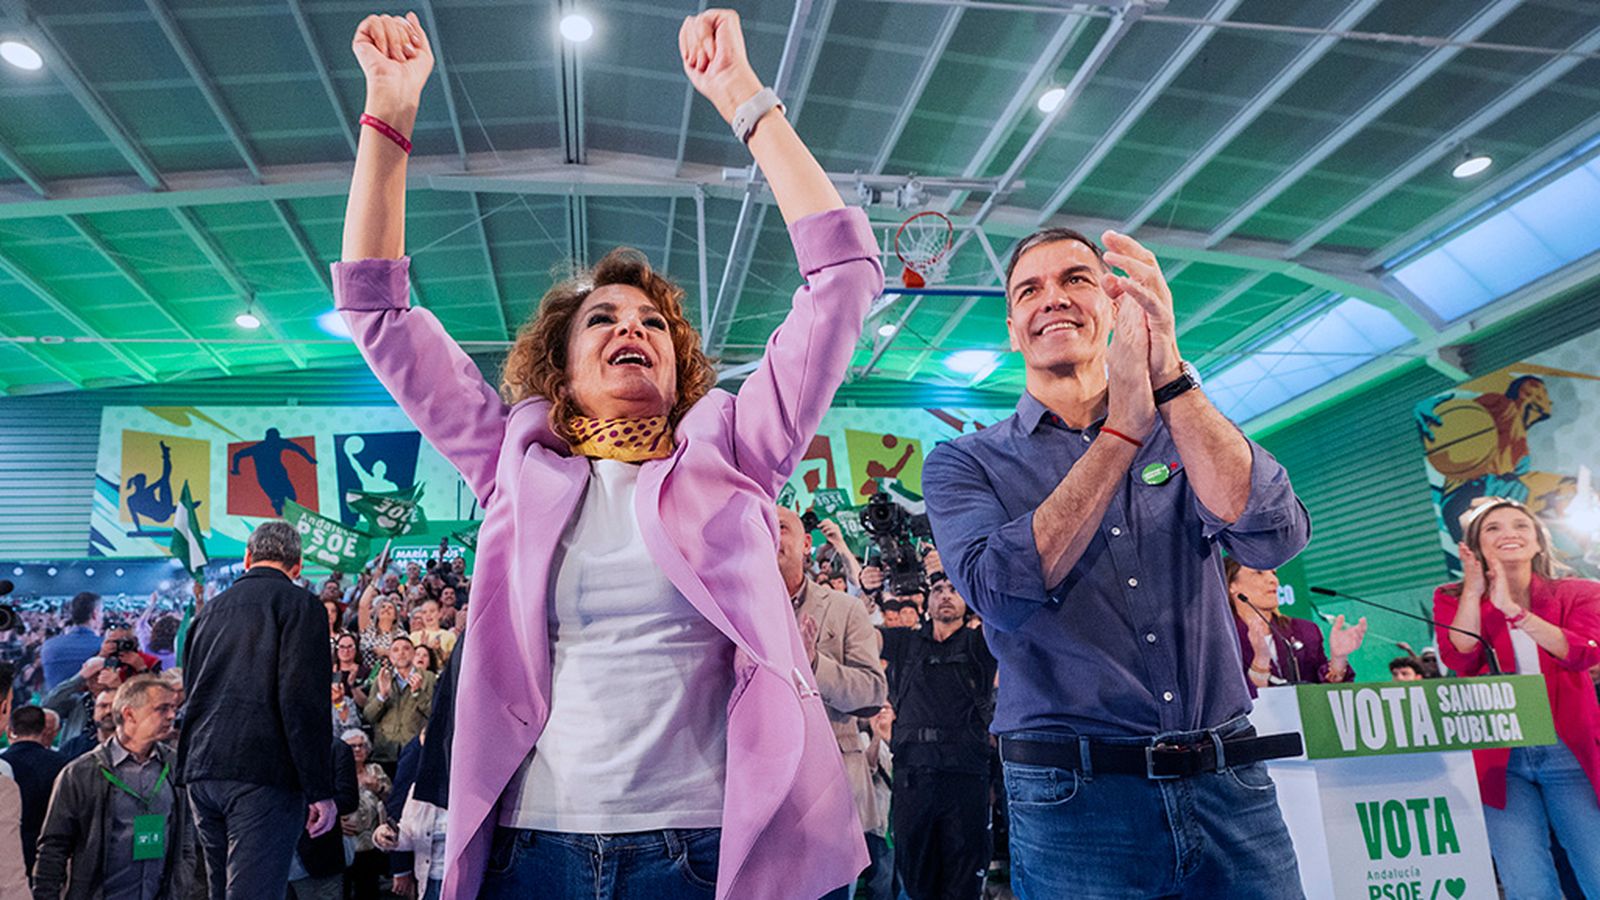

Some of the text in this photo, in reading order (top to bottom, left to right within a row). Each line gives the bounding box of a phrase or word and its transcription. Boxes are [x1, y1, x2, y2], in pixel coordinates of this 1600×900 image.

[297, 520, 358, 558] PSOE
[395, 547, 429, 558] MARÍA
[1436, 682, 1517, 713] SANIDAD
[1327, 686, 1440, 751] VOTA
[1441, 711, 1524, 745] PÚBLICA
[1355, 796, 1461, 861] VOTA
[1367, 865, 1421, 881] Andalucía
[1368, 881, 1423, 900] PSOE
